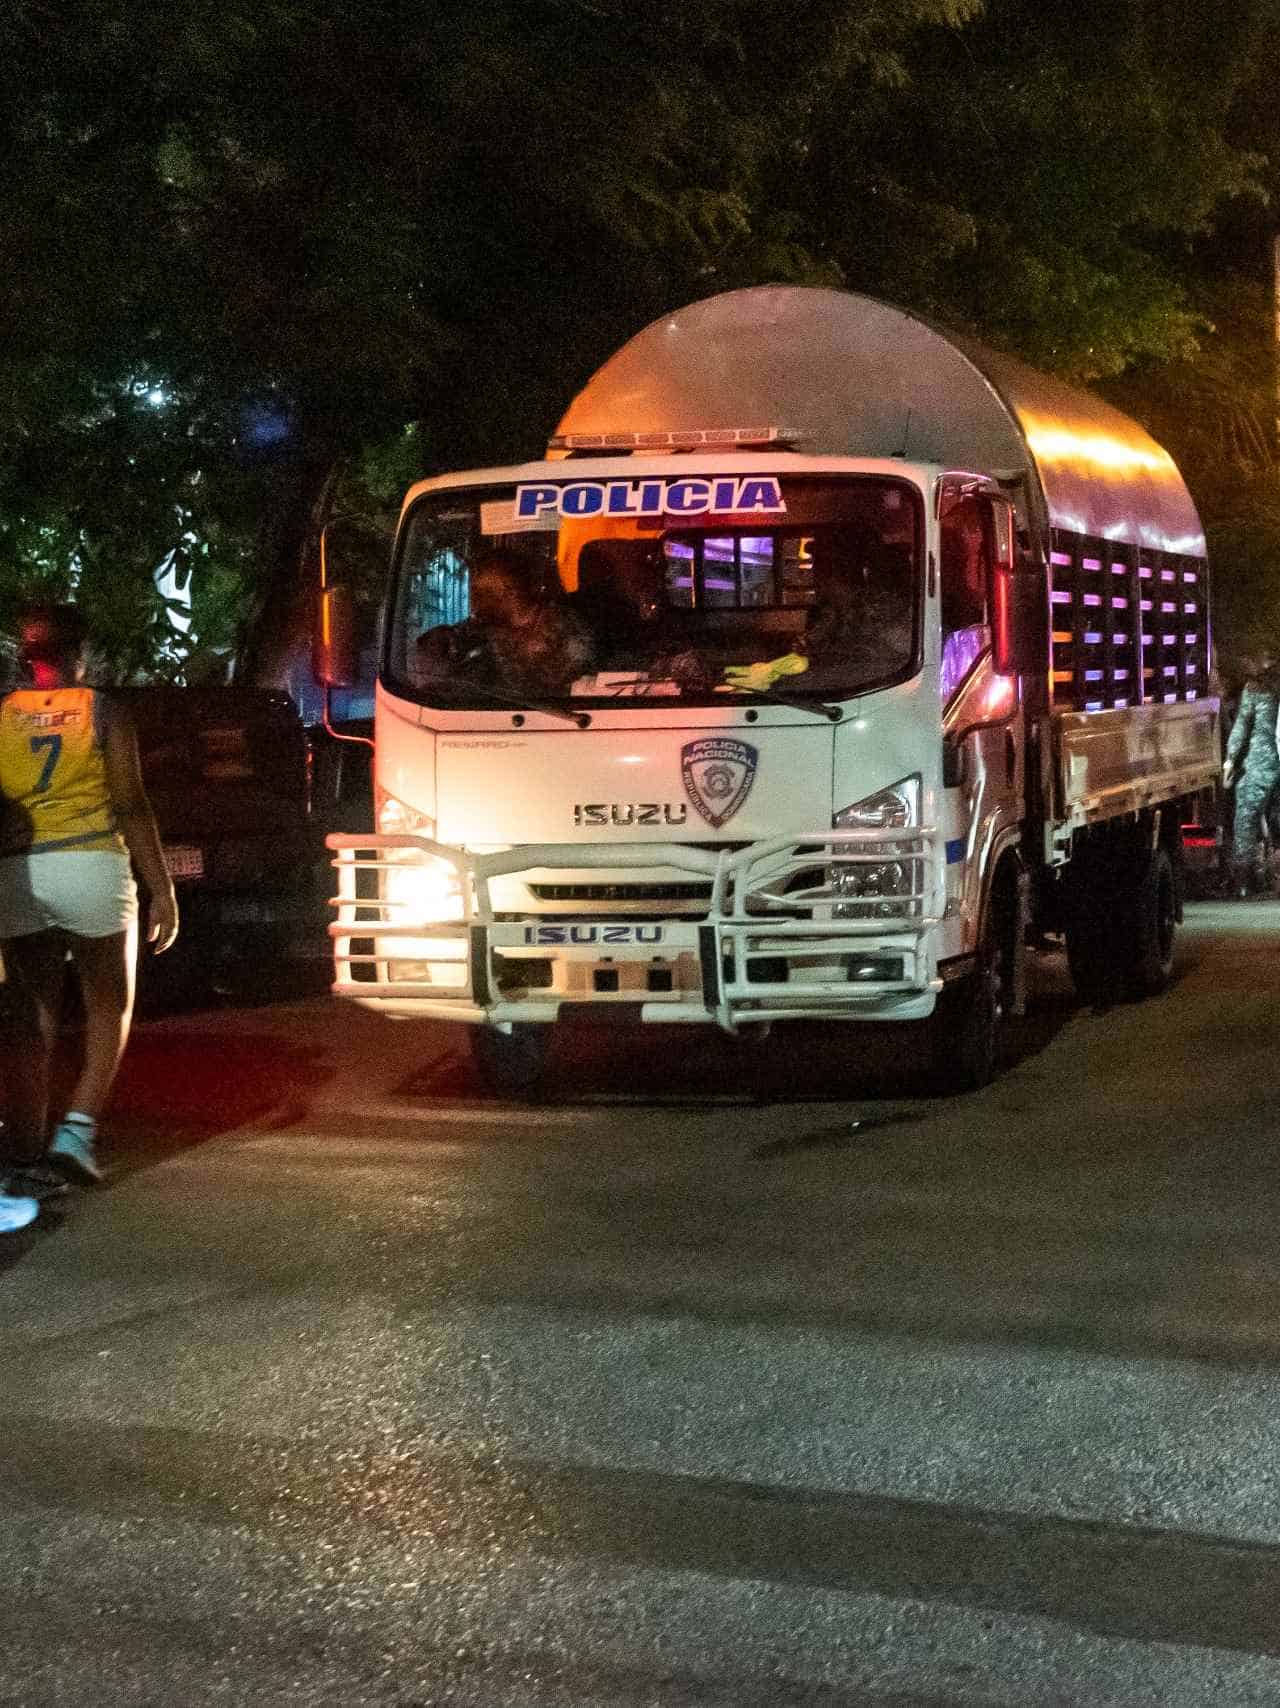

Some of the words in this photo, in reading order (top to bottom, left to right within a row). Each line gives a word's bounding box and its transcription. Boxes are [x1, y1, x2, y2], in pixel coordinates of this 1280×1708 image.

[515, 478, 785, 518] POLICIA
[693, 741, 746, 752] POLICIA
[30, 734, 62, 793] 7
[683, 751, 755, 768] NACIONAL
[574, 803, 687, 826] ISUZU
[523, 925, 663, 945] ISUZU
